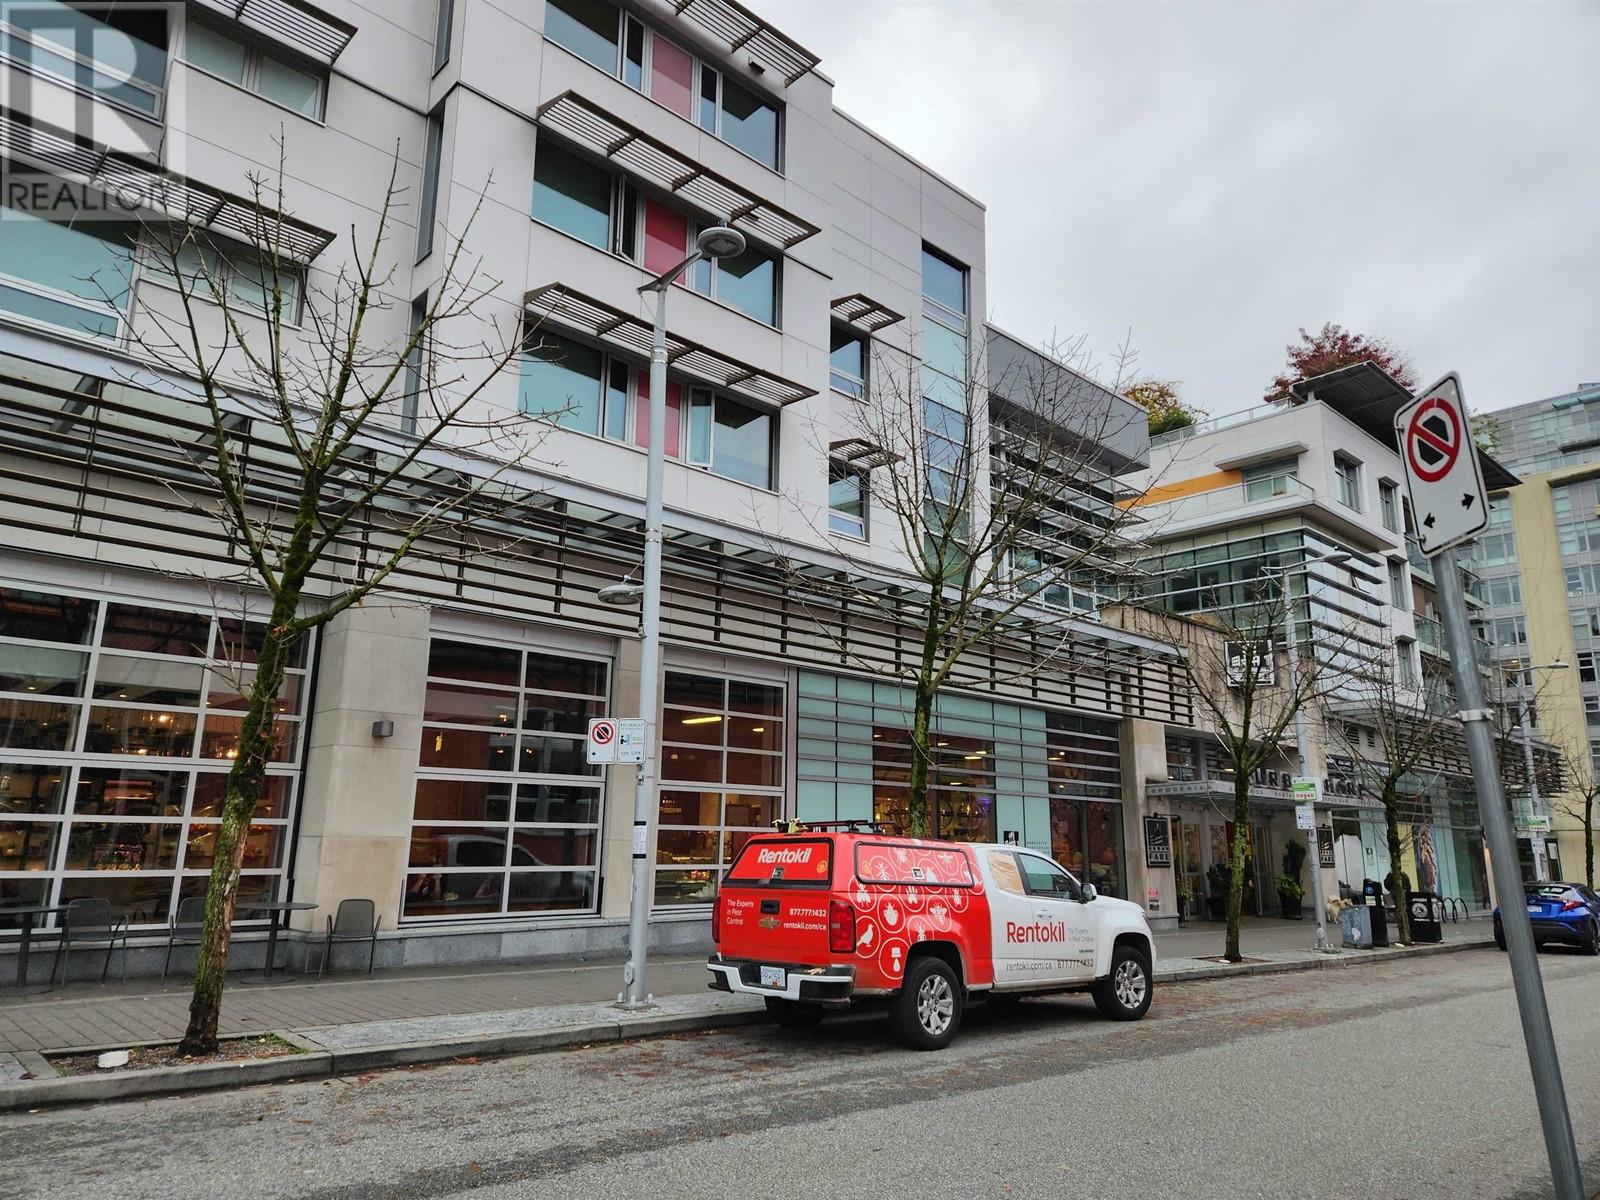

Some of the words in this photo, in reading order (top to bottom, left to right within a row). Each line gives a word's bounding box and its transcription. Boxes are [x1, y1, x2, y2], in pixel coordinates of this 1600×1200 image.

[757, 848, 812, 863] Rentokil
[1149, 853, 1169, 861] FARE
[727, 899, 736, 907] The
[736, 900, 754, 909] Experts
[732, 908, 742, 916] Pest
[789, 908, 827, 917] 877.777.1432
[726, 917, 743, 925] Control
[783, 922, 827, 931] rentokil.com/ca
[1007, 922, 1065, 942] Rentokil
